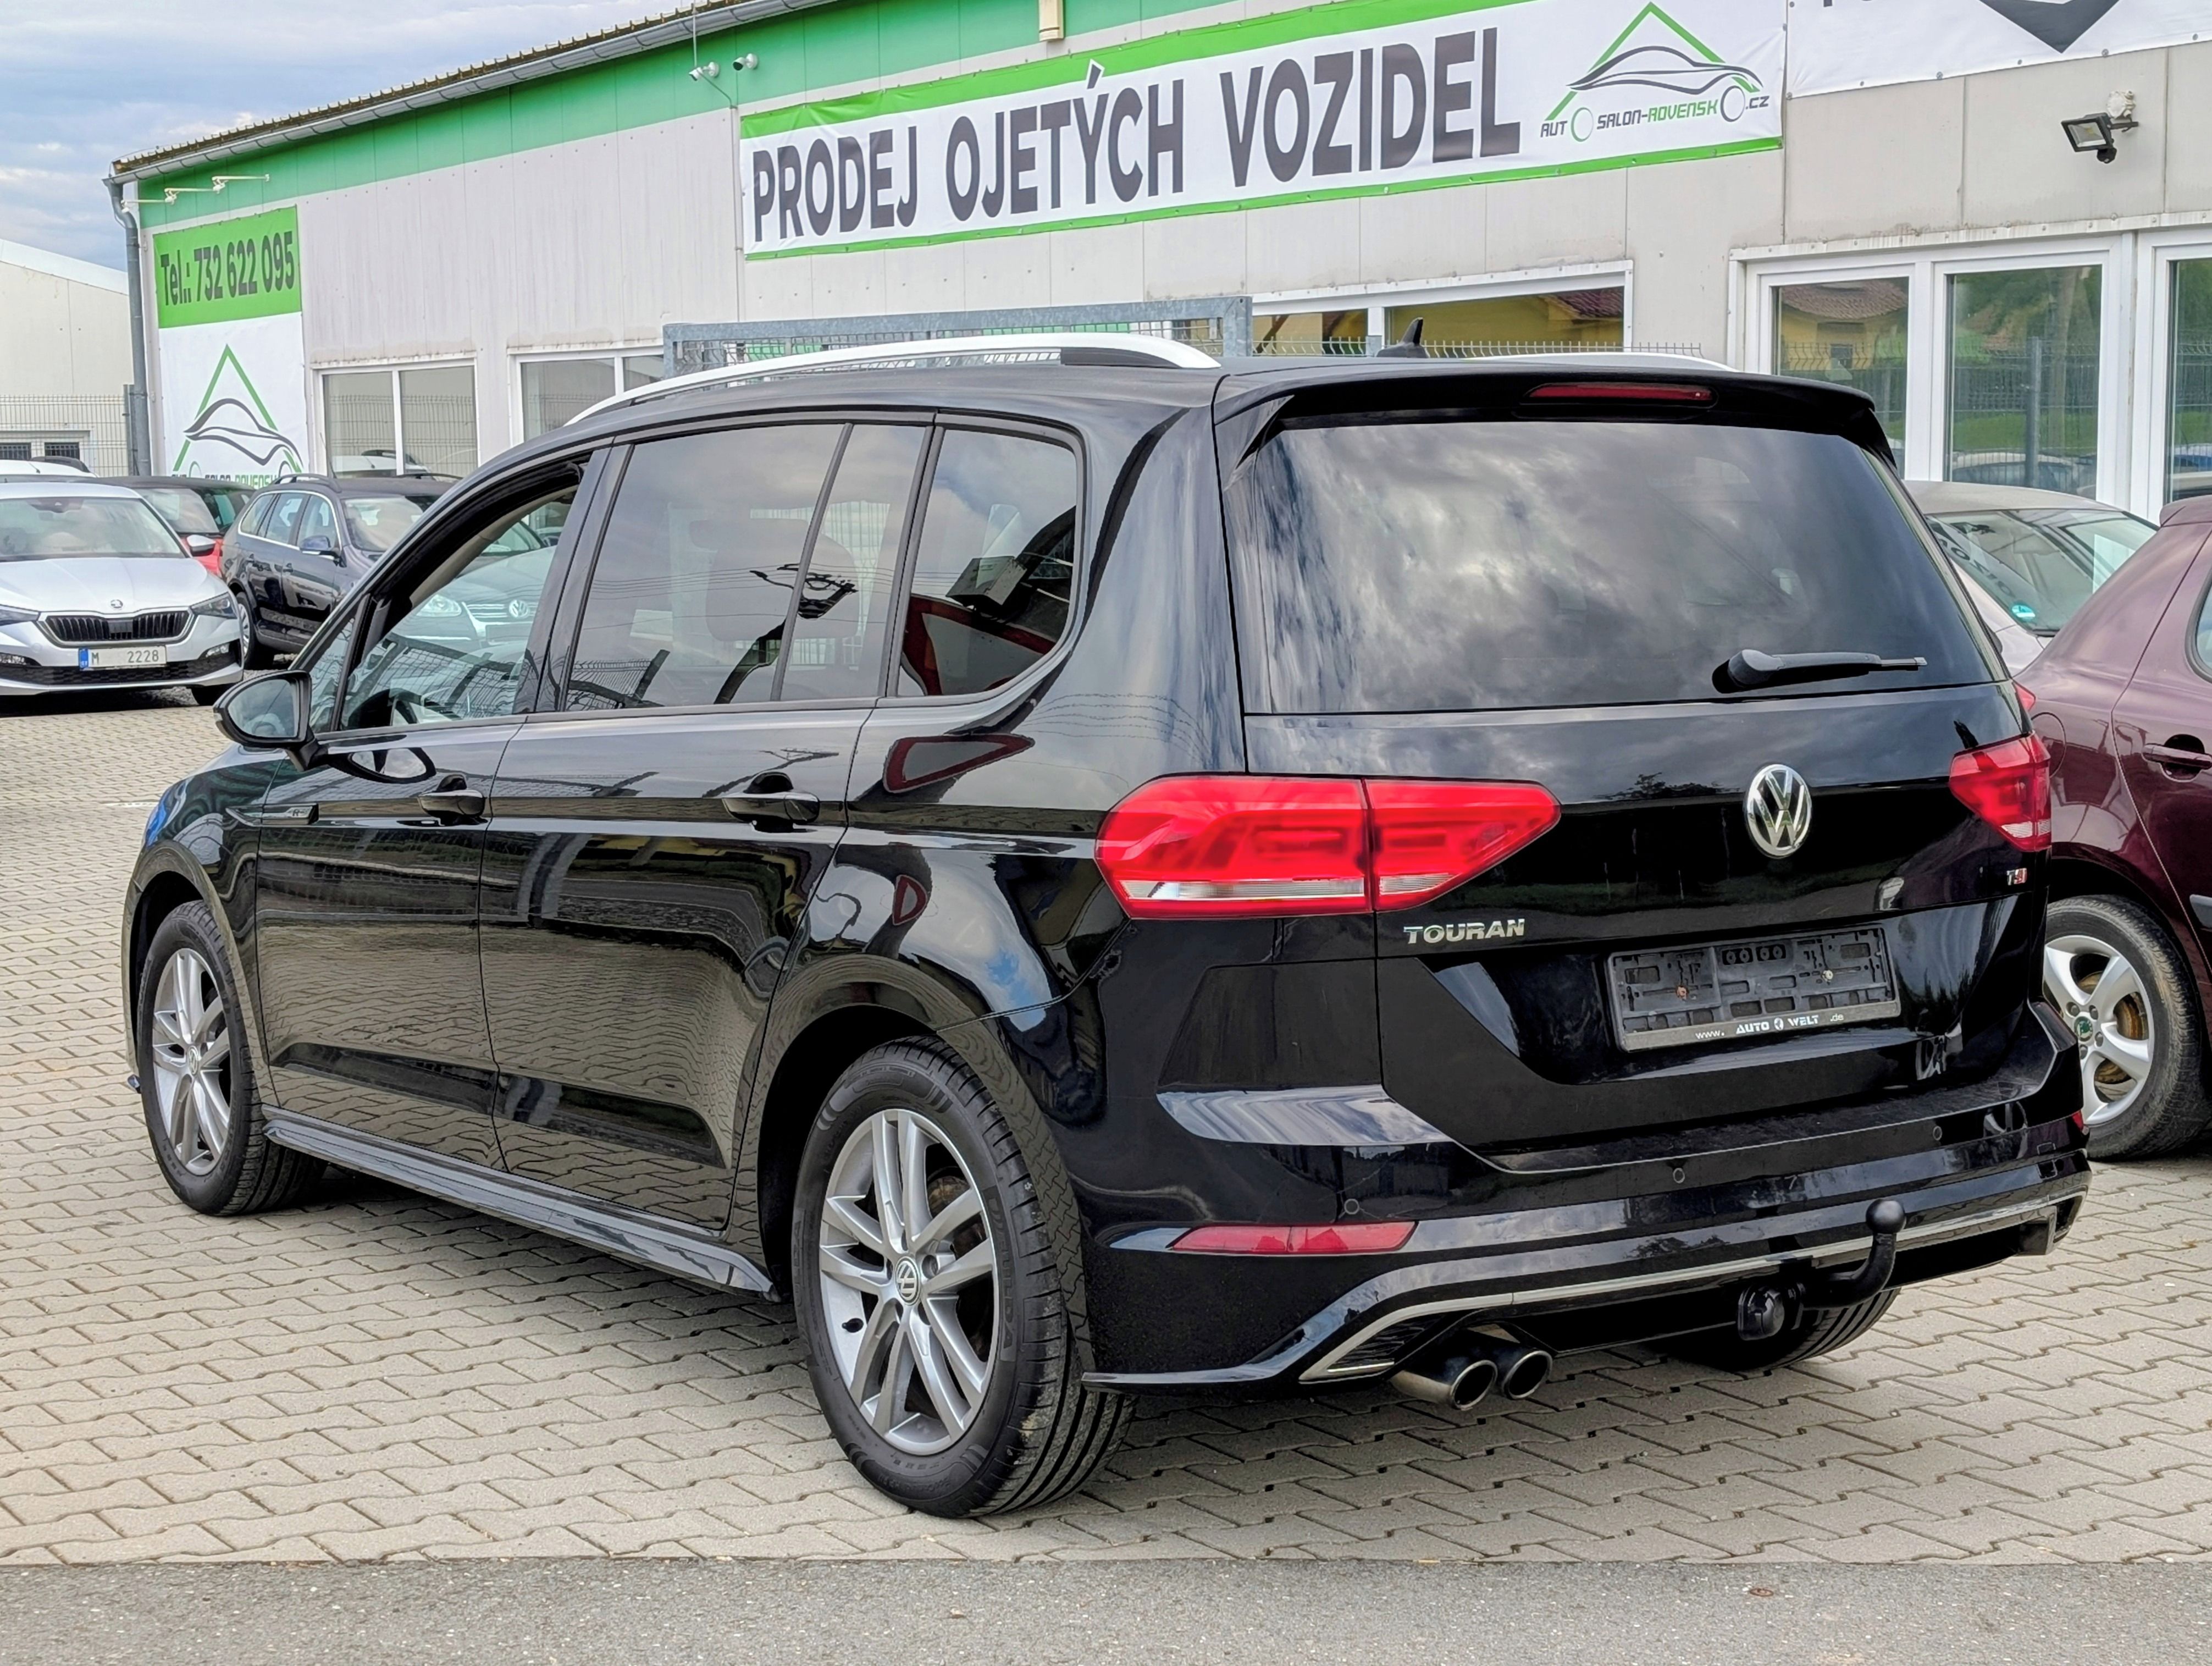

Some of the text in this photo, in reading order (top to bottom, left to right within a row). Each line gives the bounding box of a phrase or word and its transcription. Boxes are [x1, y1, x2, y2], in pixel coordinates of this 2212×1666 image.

[753, 27, 1520, 242] PRODEJ OJETÝCH VOZIDEL
[161, 231, 295, 306] Tel.: 732 622 095
[91, 652, 99, 665] M
[127, 650, 159, 663] 2228
[1403, 918, 1525, 944] TOURAN
[1695, 1013, 1844, 1040] www. AUTO WELT .de
